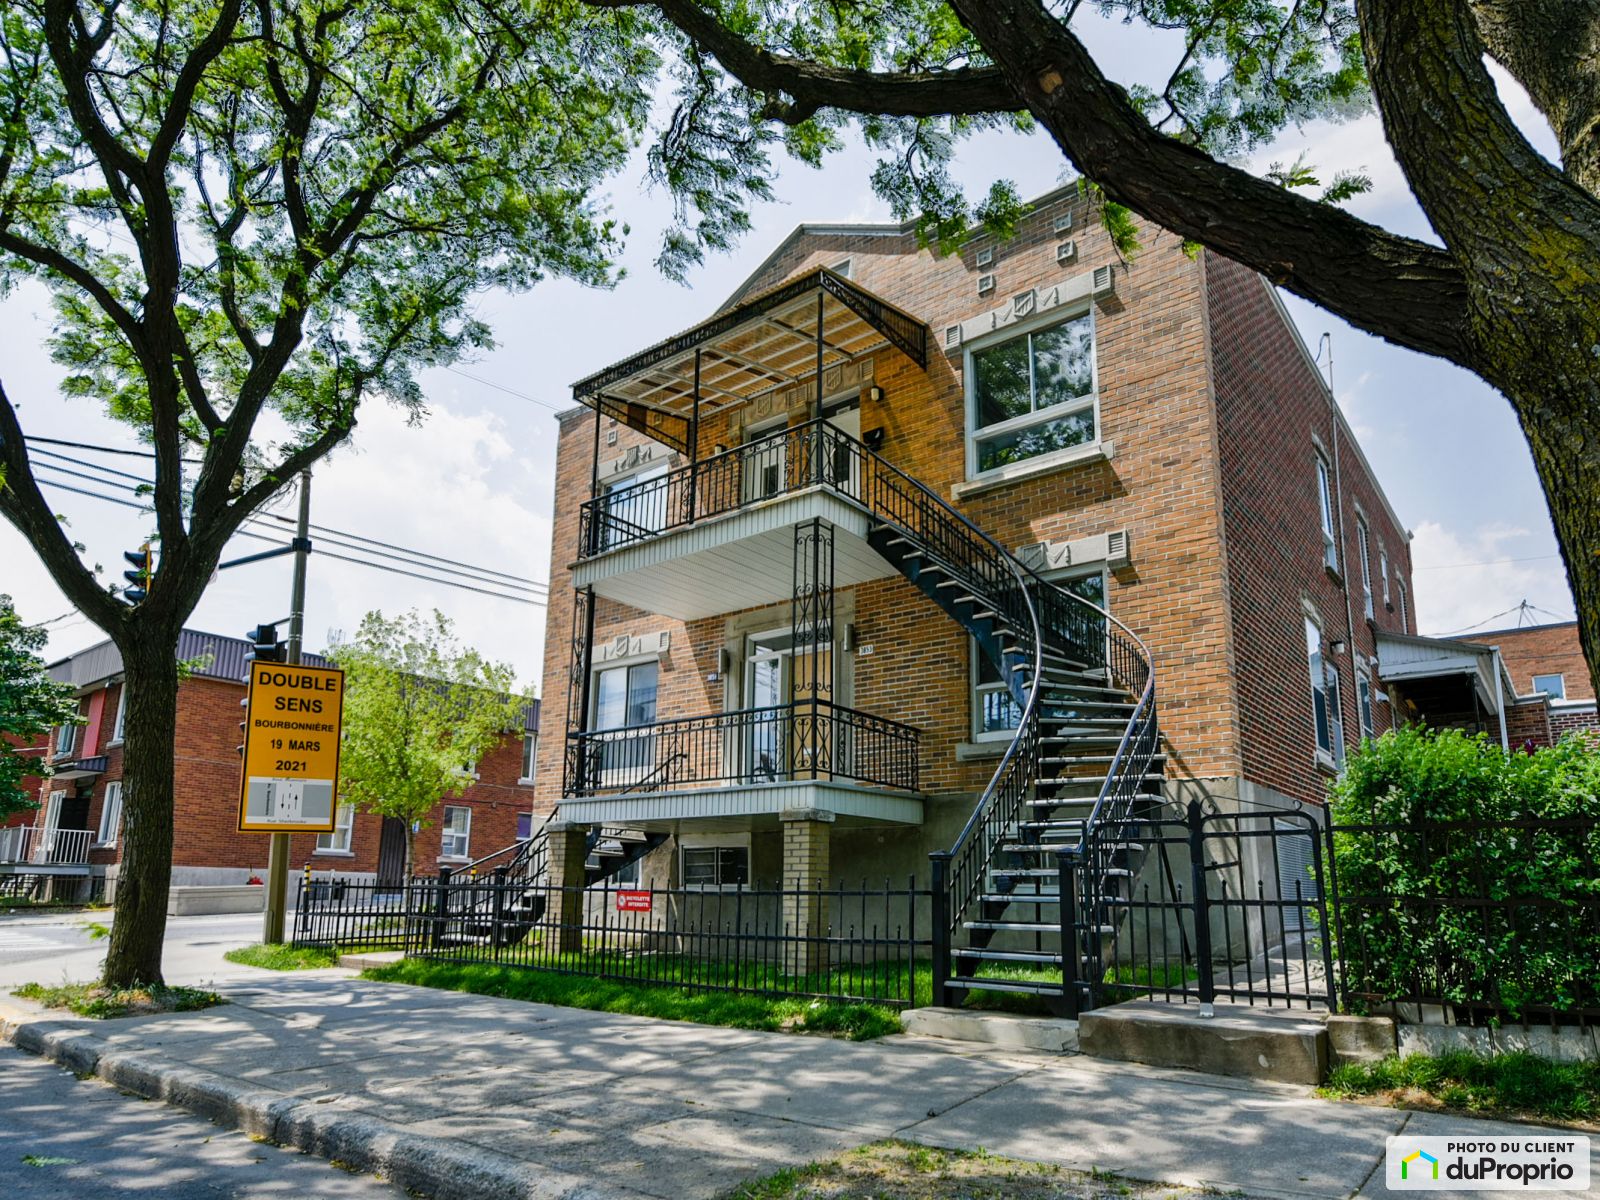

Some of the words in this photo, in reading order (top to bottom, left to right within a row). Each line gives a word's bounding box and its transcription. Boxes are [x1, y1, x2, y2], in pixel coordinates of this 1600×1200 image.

[259, 671, 336, 692] DOUBLE
[274, 696, 323, 713] SENS
[255, 719, 334, 732] BOURBONNIÈRE
[270, 739, 282, 750] 19
[288, 739, 321, 752] MARS
[275, 760, 307, 771] 2021
